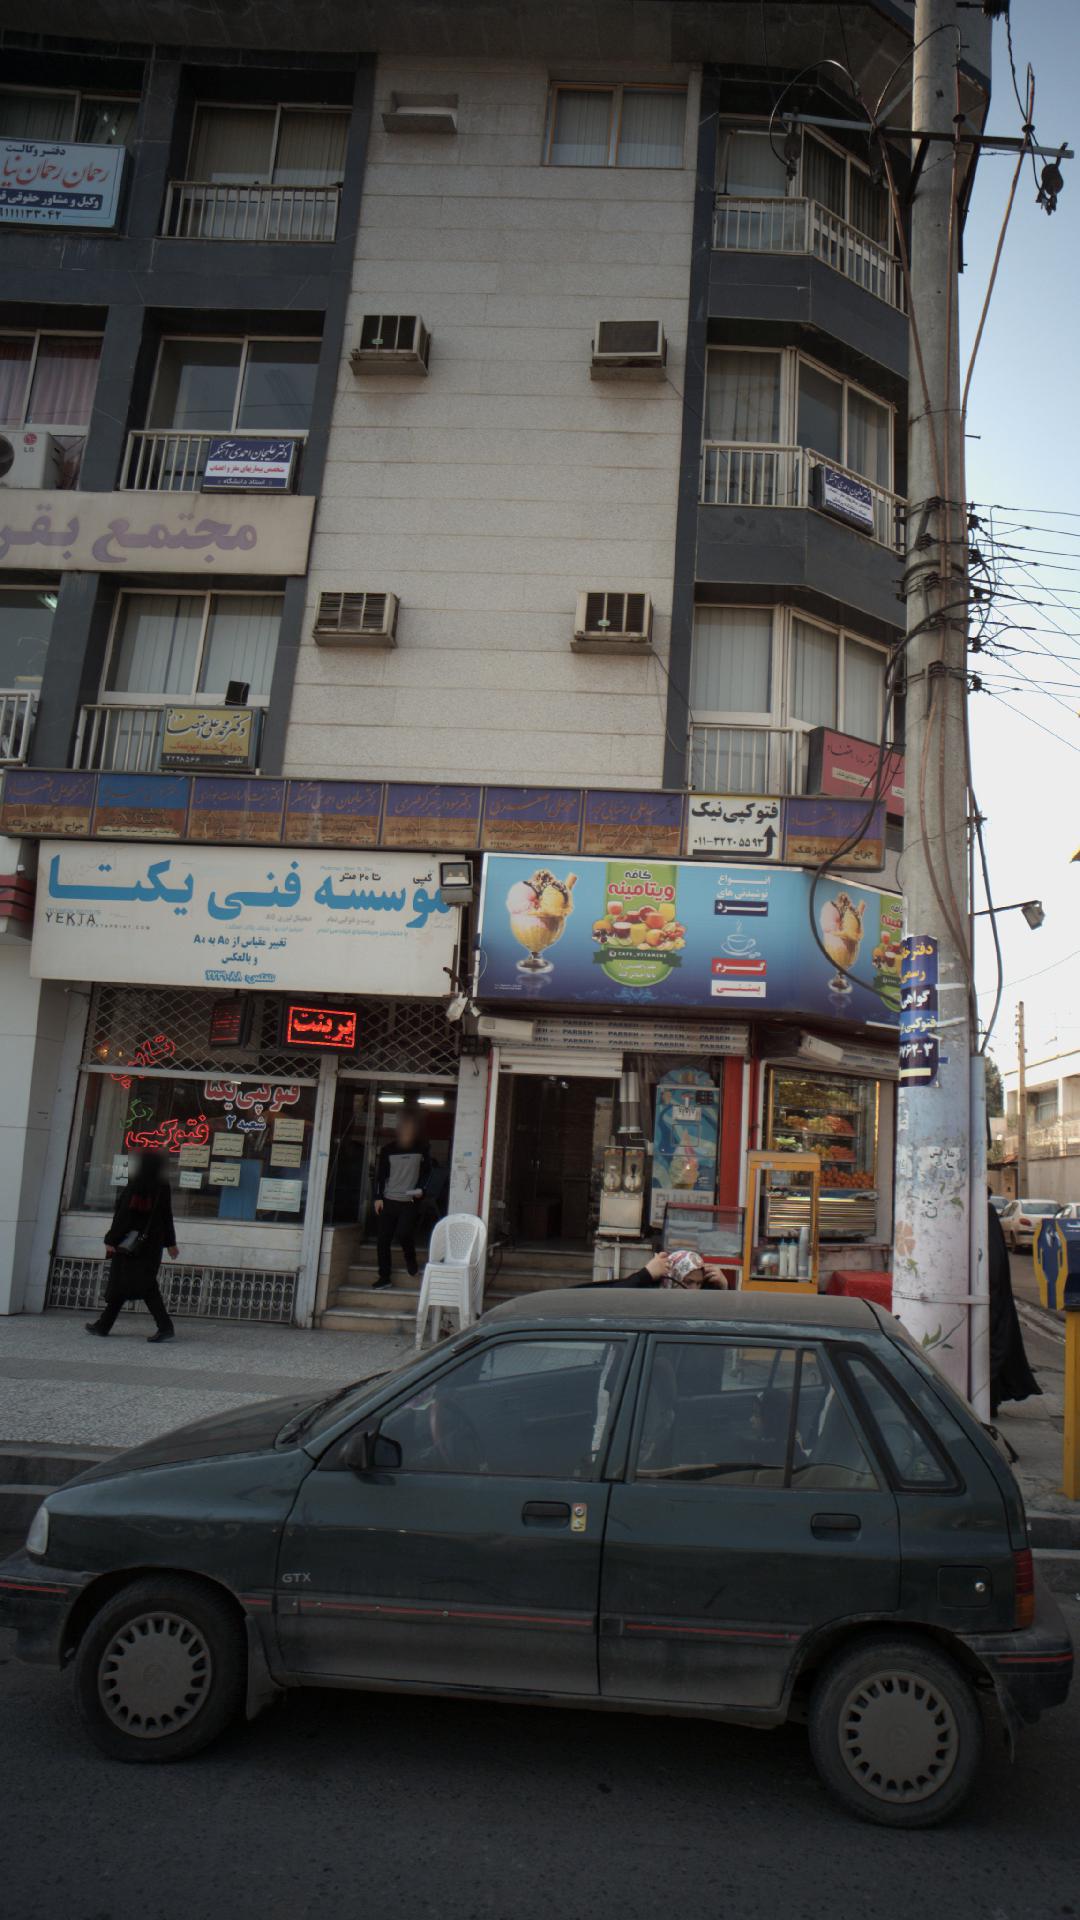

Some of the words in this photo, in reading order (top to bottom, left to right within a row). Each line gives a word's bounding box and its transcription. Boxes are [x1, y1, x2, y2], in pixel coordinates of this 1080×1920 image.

[6, 144, 38, 157] وکالت
[40, 146, 66, 157] دفتر
[41, 194, 68, 206] مشاور
[70, 199, 76, 207] و
[77, 197, 99, 208] وکیل
[0, 504, 79, 562] بقر
[92, 512, 257, 564] مجتمع
[218, 714, 250, 743] دکتر
[691, 801, 722, 822] نیک
[339, 872, 357, 882] متر
[412, 872, 433, 887] کپی
[624, 869, 652, 880] کافه
[48, 854, 194, 917] یکتا
[207, 861, 302, 921] فنی
[607, 881, 675, 901] ویتامینه
[716, 888, 734, 900] های
[735, 888, 769, 901] نوشیدنی
[717, 902, 768, 913] سرد
[45, 911, 96, 927] YEKTA
[231, 936, 240, 948] از
[241, 936, 266, 948] مقیاس
[268, 937, 288, 950] تغییر
[221, 952, 251, 965] بالعکس
[911, 943, 934, 961] دفتر
[715, 961, 766, 974] گرم
[293, 1012, 353, 1043] پرینت
[225, 1114, 237, 1130] ۲
[237, 1116, 267, 1133] شعبه
[282, 1573, 312, 1583] GTX
